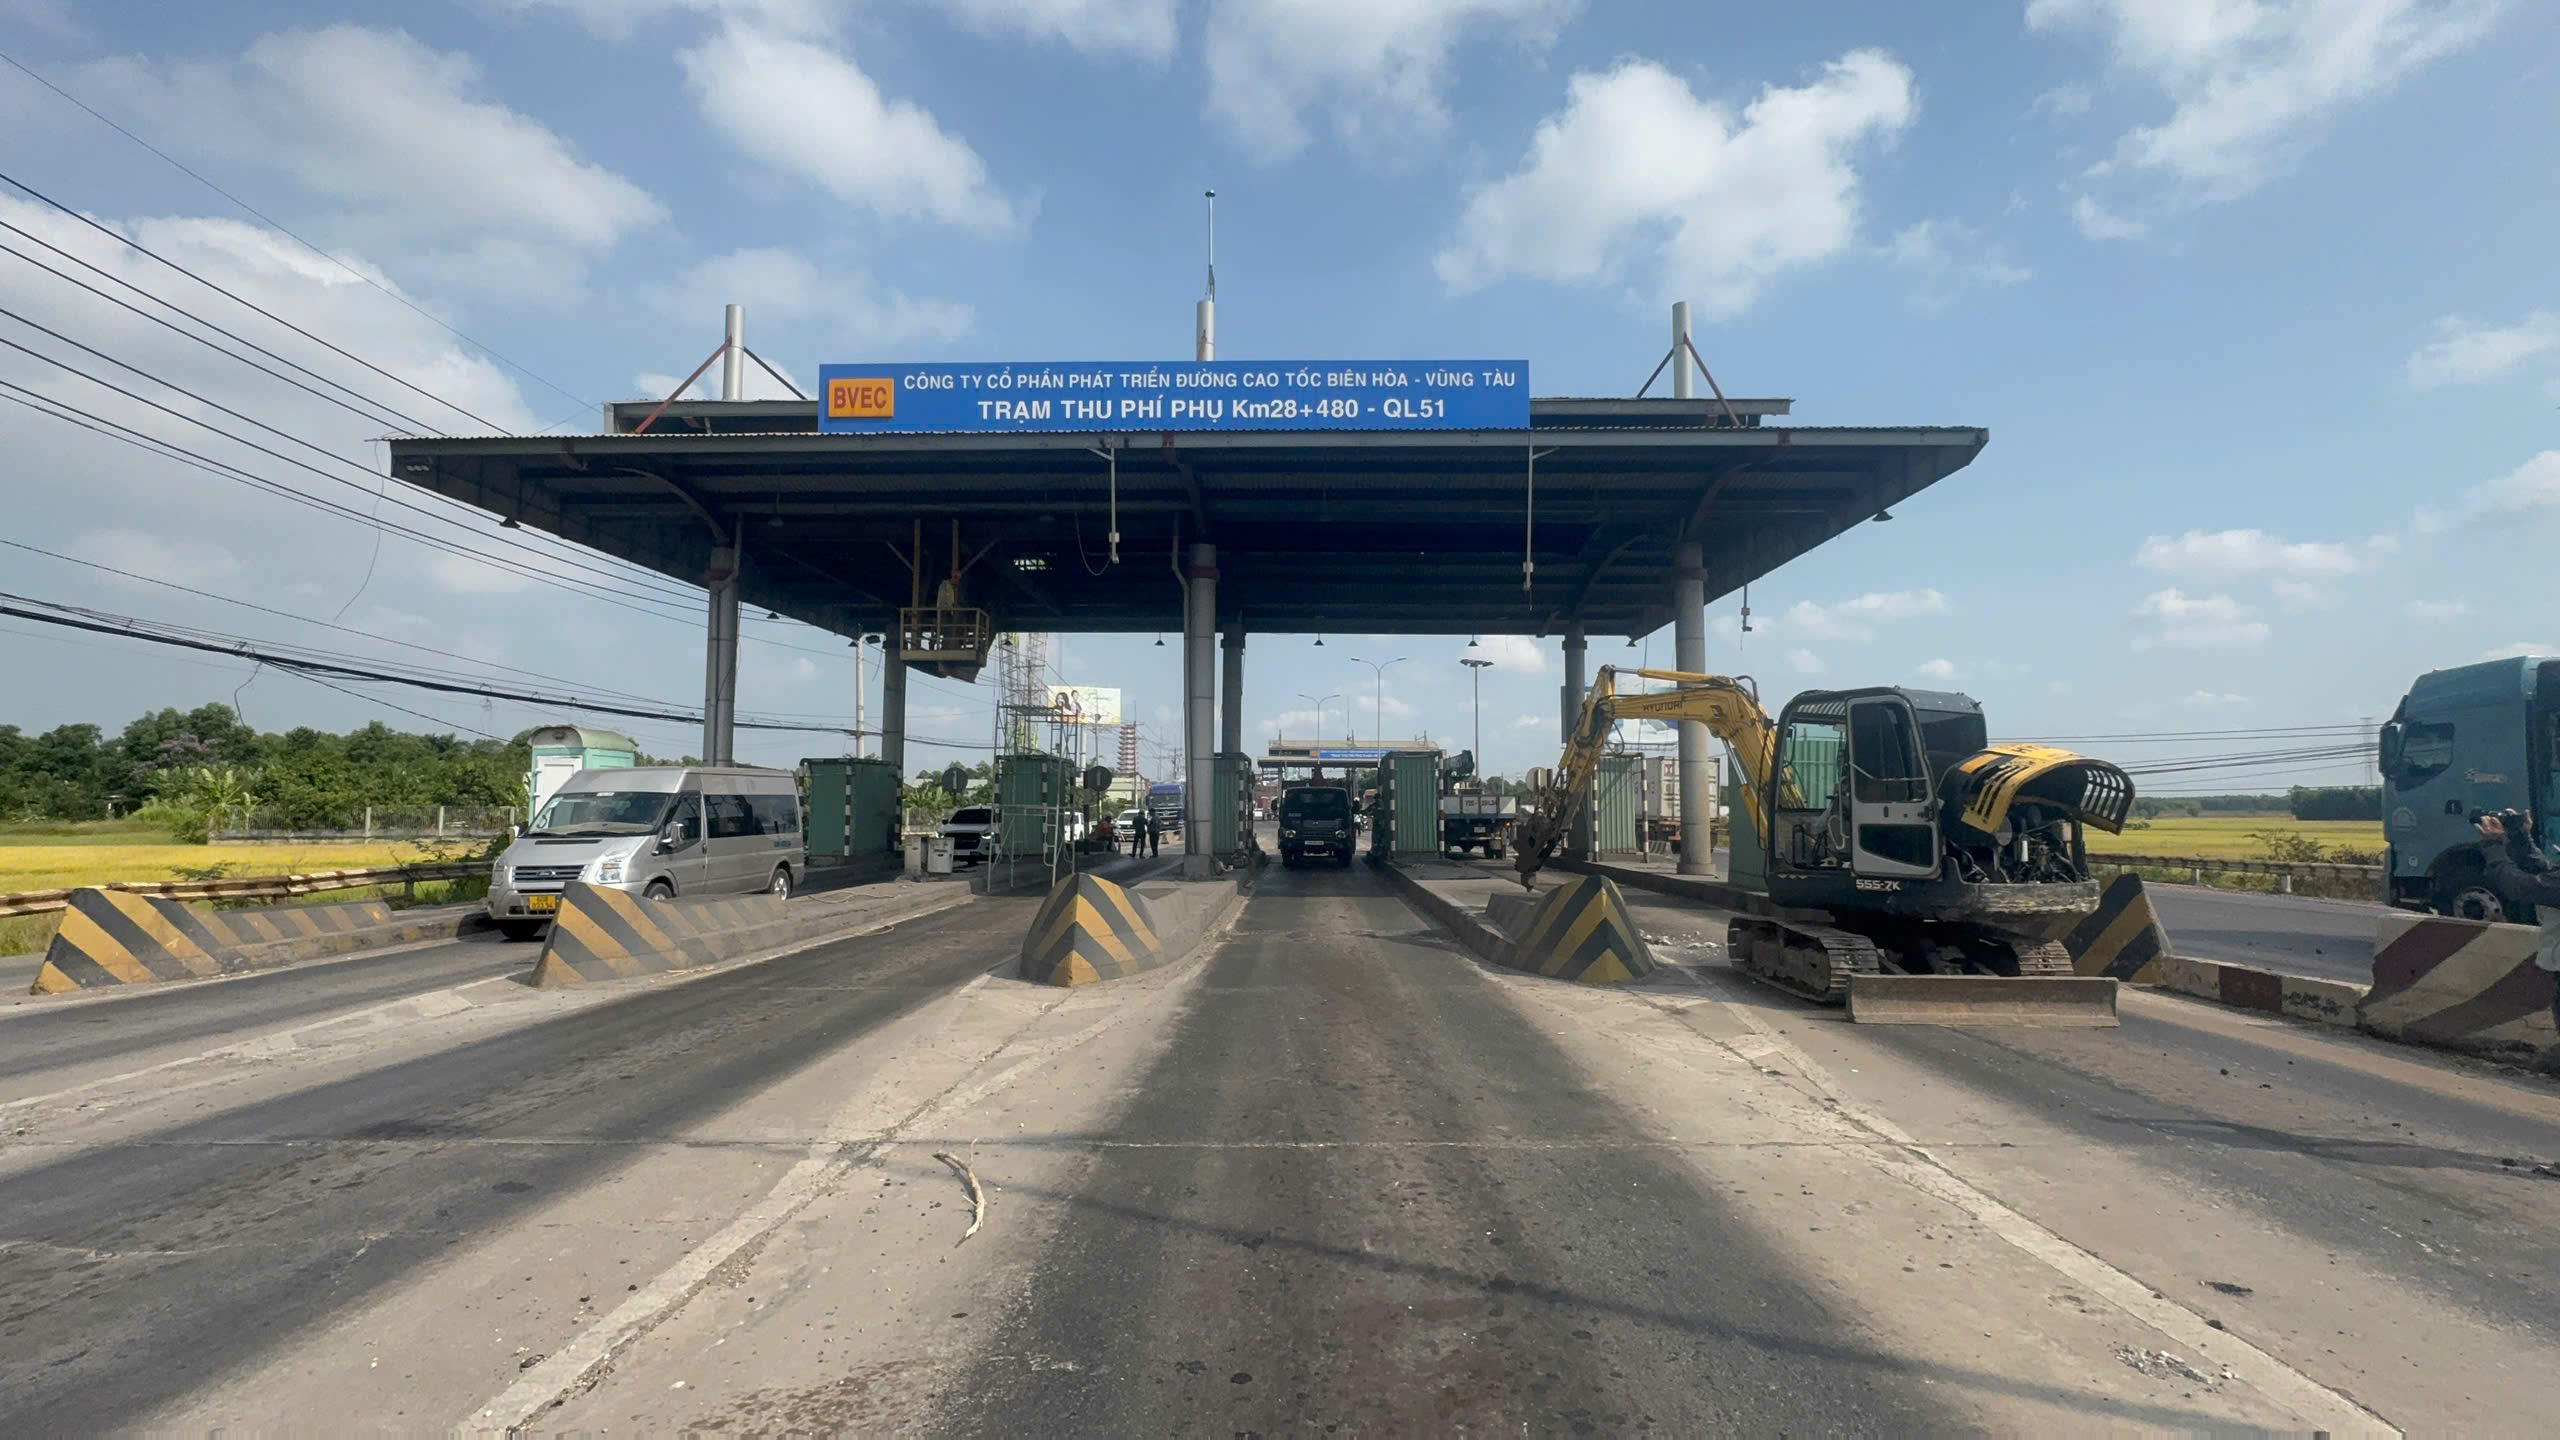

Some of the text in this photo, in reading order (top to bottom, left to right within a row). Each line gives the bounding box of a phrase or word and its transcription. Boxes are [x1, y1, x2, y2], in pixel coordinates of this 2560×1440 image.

[904, 371, 954, 390] CÔNG
[960, 374, 982, 389] TY
[986, 366, 1012, 389] CỔ
[1017, 368, 1064, 389] PHẦN
[1069, 370, 1113, 388] PHÁT
[1119, 365, 1170, 388] TRIỂN
[1176, 368, 1237, 388] ĐƯỜNG
[1243, 372, 1279, 387] CAO
[1285, 367, 1321, 387] TỐC
[1327, 368, 1366, 387] BIÊN
[1372, 368, 1408, 387] HÒA
[1425, 368, 1474, 387] VŨNG
[1482, 368, 1516, 387] TÀU
[834, 386, 887, 409] BVEC
[977, 401, 1050, 424] TRẠM
[1060, 400, 1112, 419] THU
[1121, 394, 1164, 418] PHÍ
[1171, 399, 1223, 423] PHỤ
[1232, 399, 1358, 418] Km28+480
[1383, 398, 1444, 418] QL51
